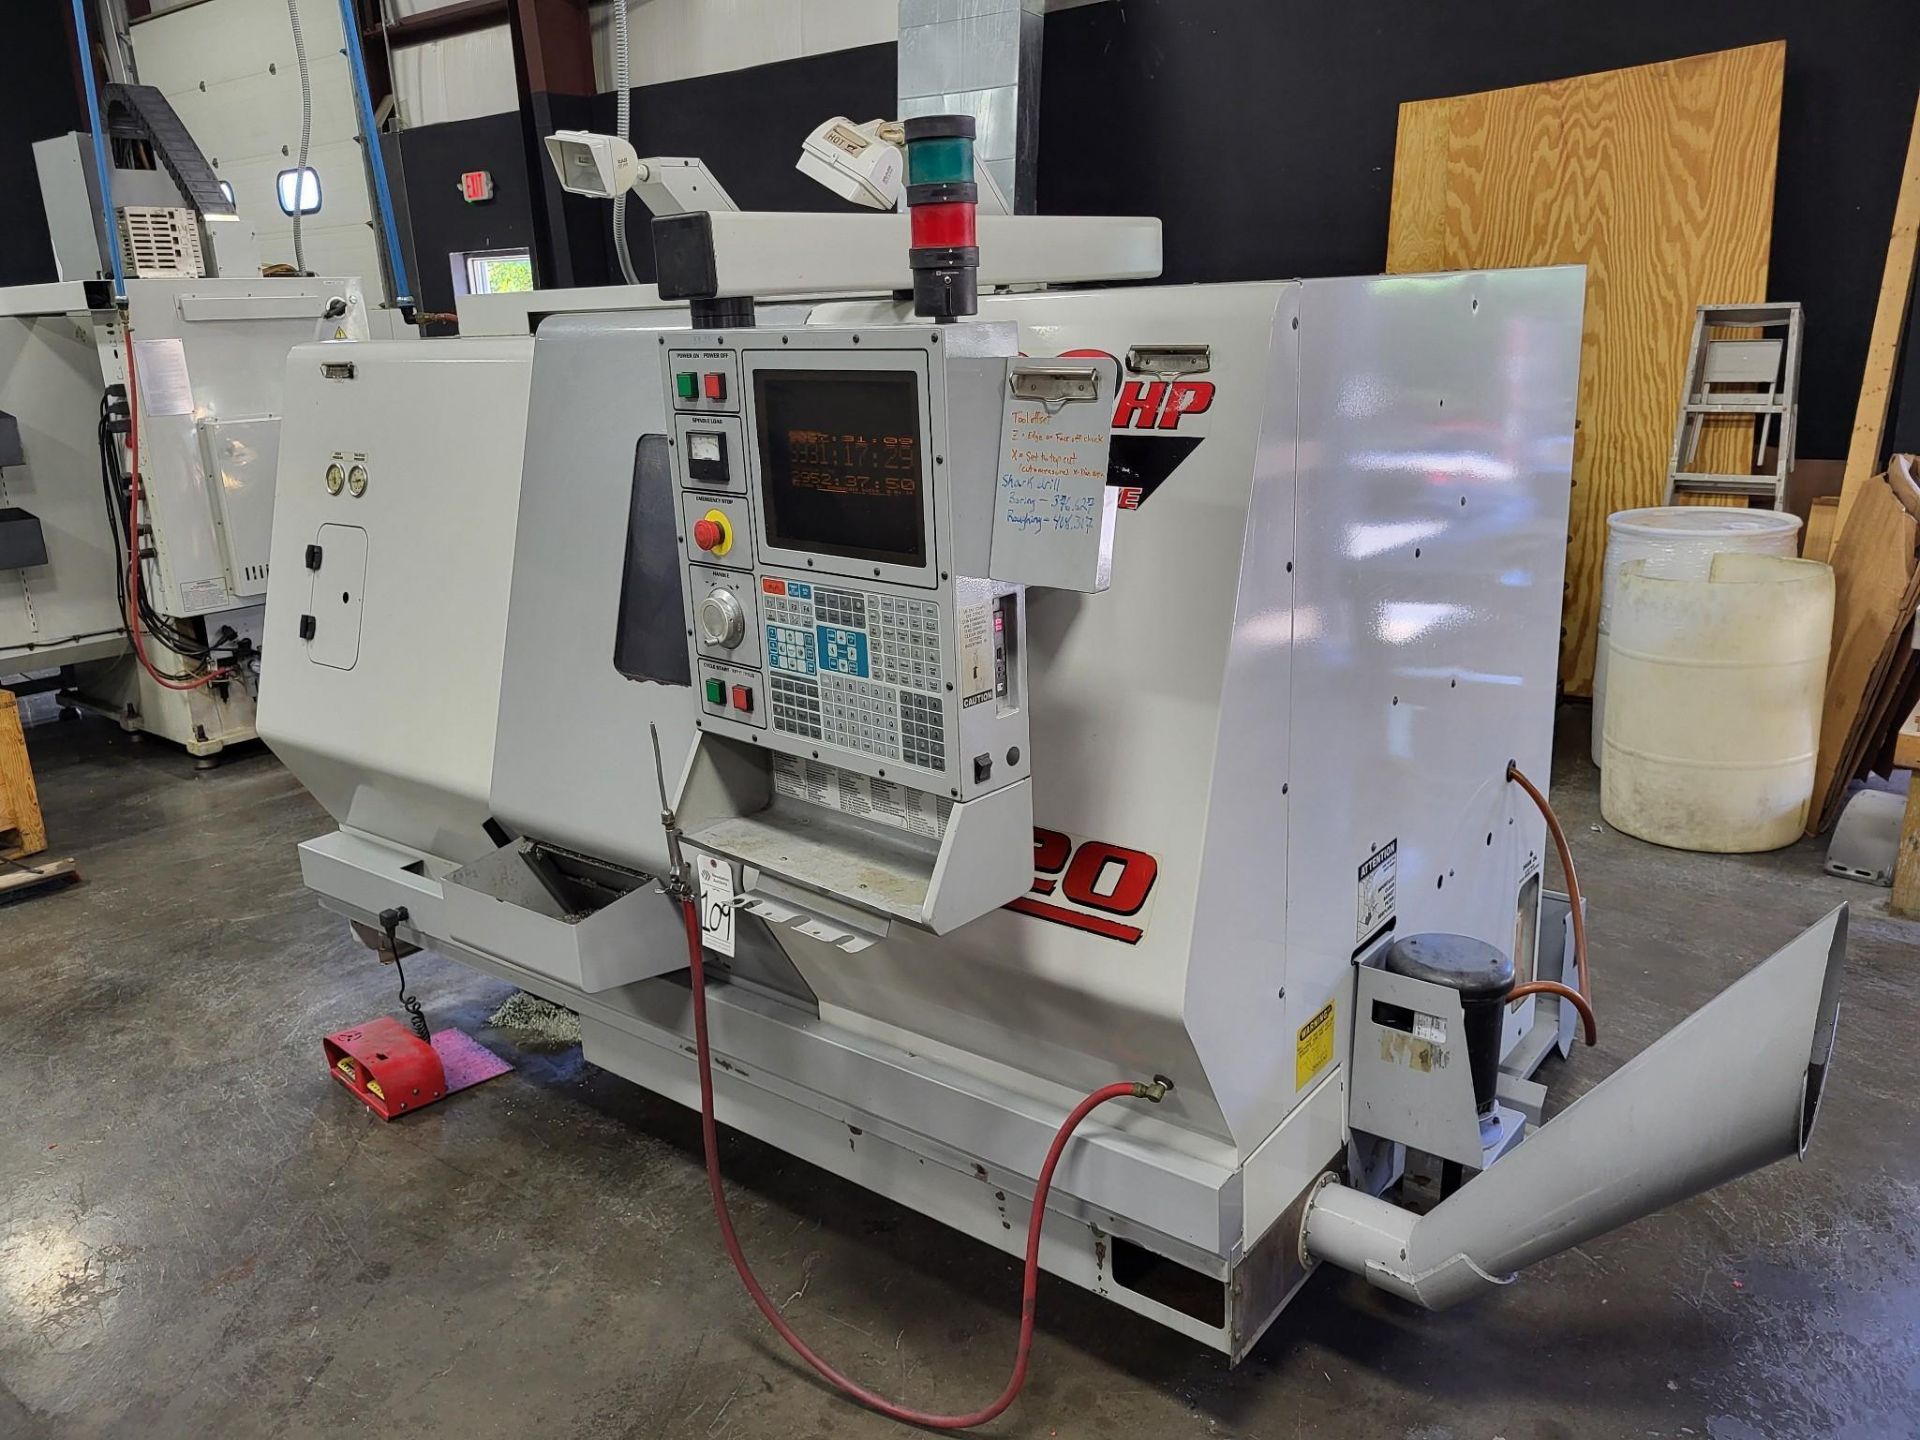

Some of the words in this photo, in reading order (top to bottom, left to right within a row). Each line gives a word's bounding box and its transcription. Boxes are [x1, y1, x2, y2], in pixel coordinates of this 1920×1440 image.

[828, 133, 845, 146] HOT
[1111, 381, 1216, 430] HP
[1002, 473, 1034, 489] Shark
[1118, 487, 1143, 510] E
[963, 691, 992, 708] CAUTION
[1360, 842, 1396, 879] ATTENTION
[701, 890, 731, 941] 109
